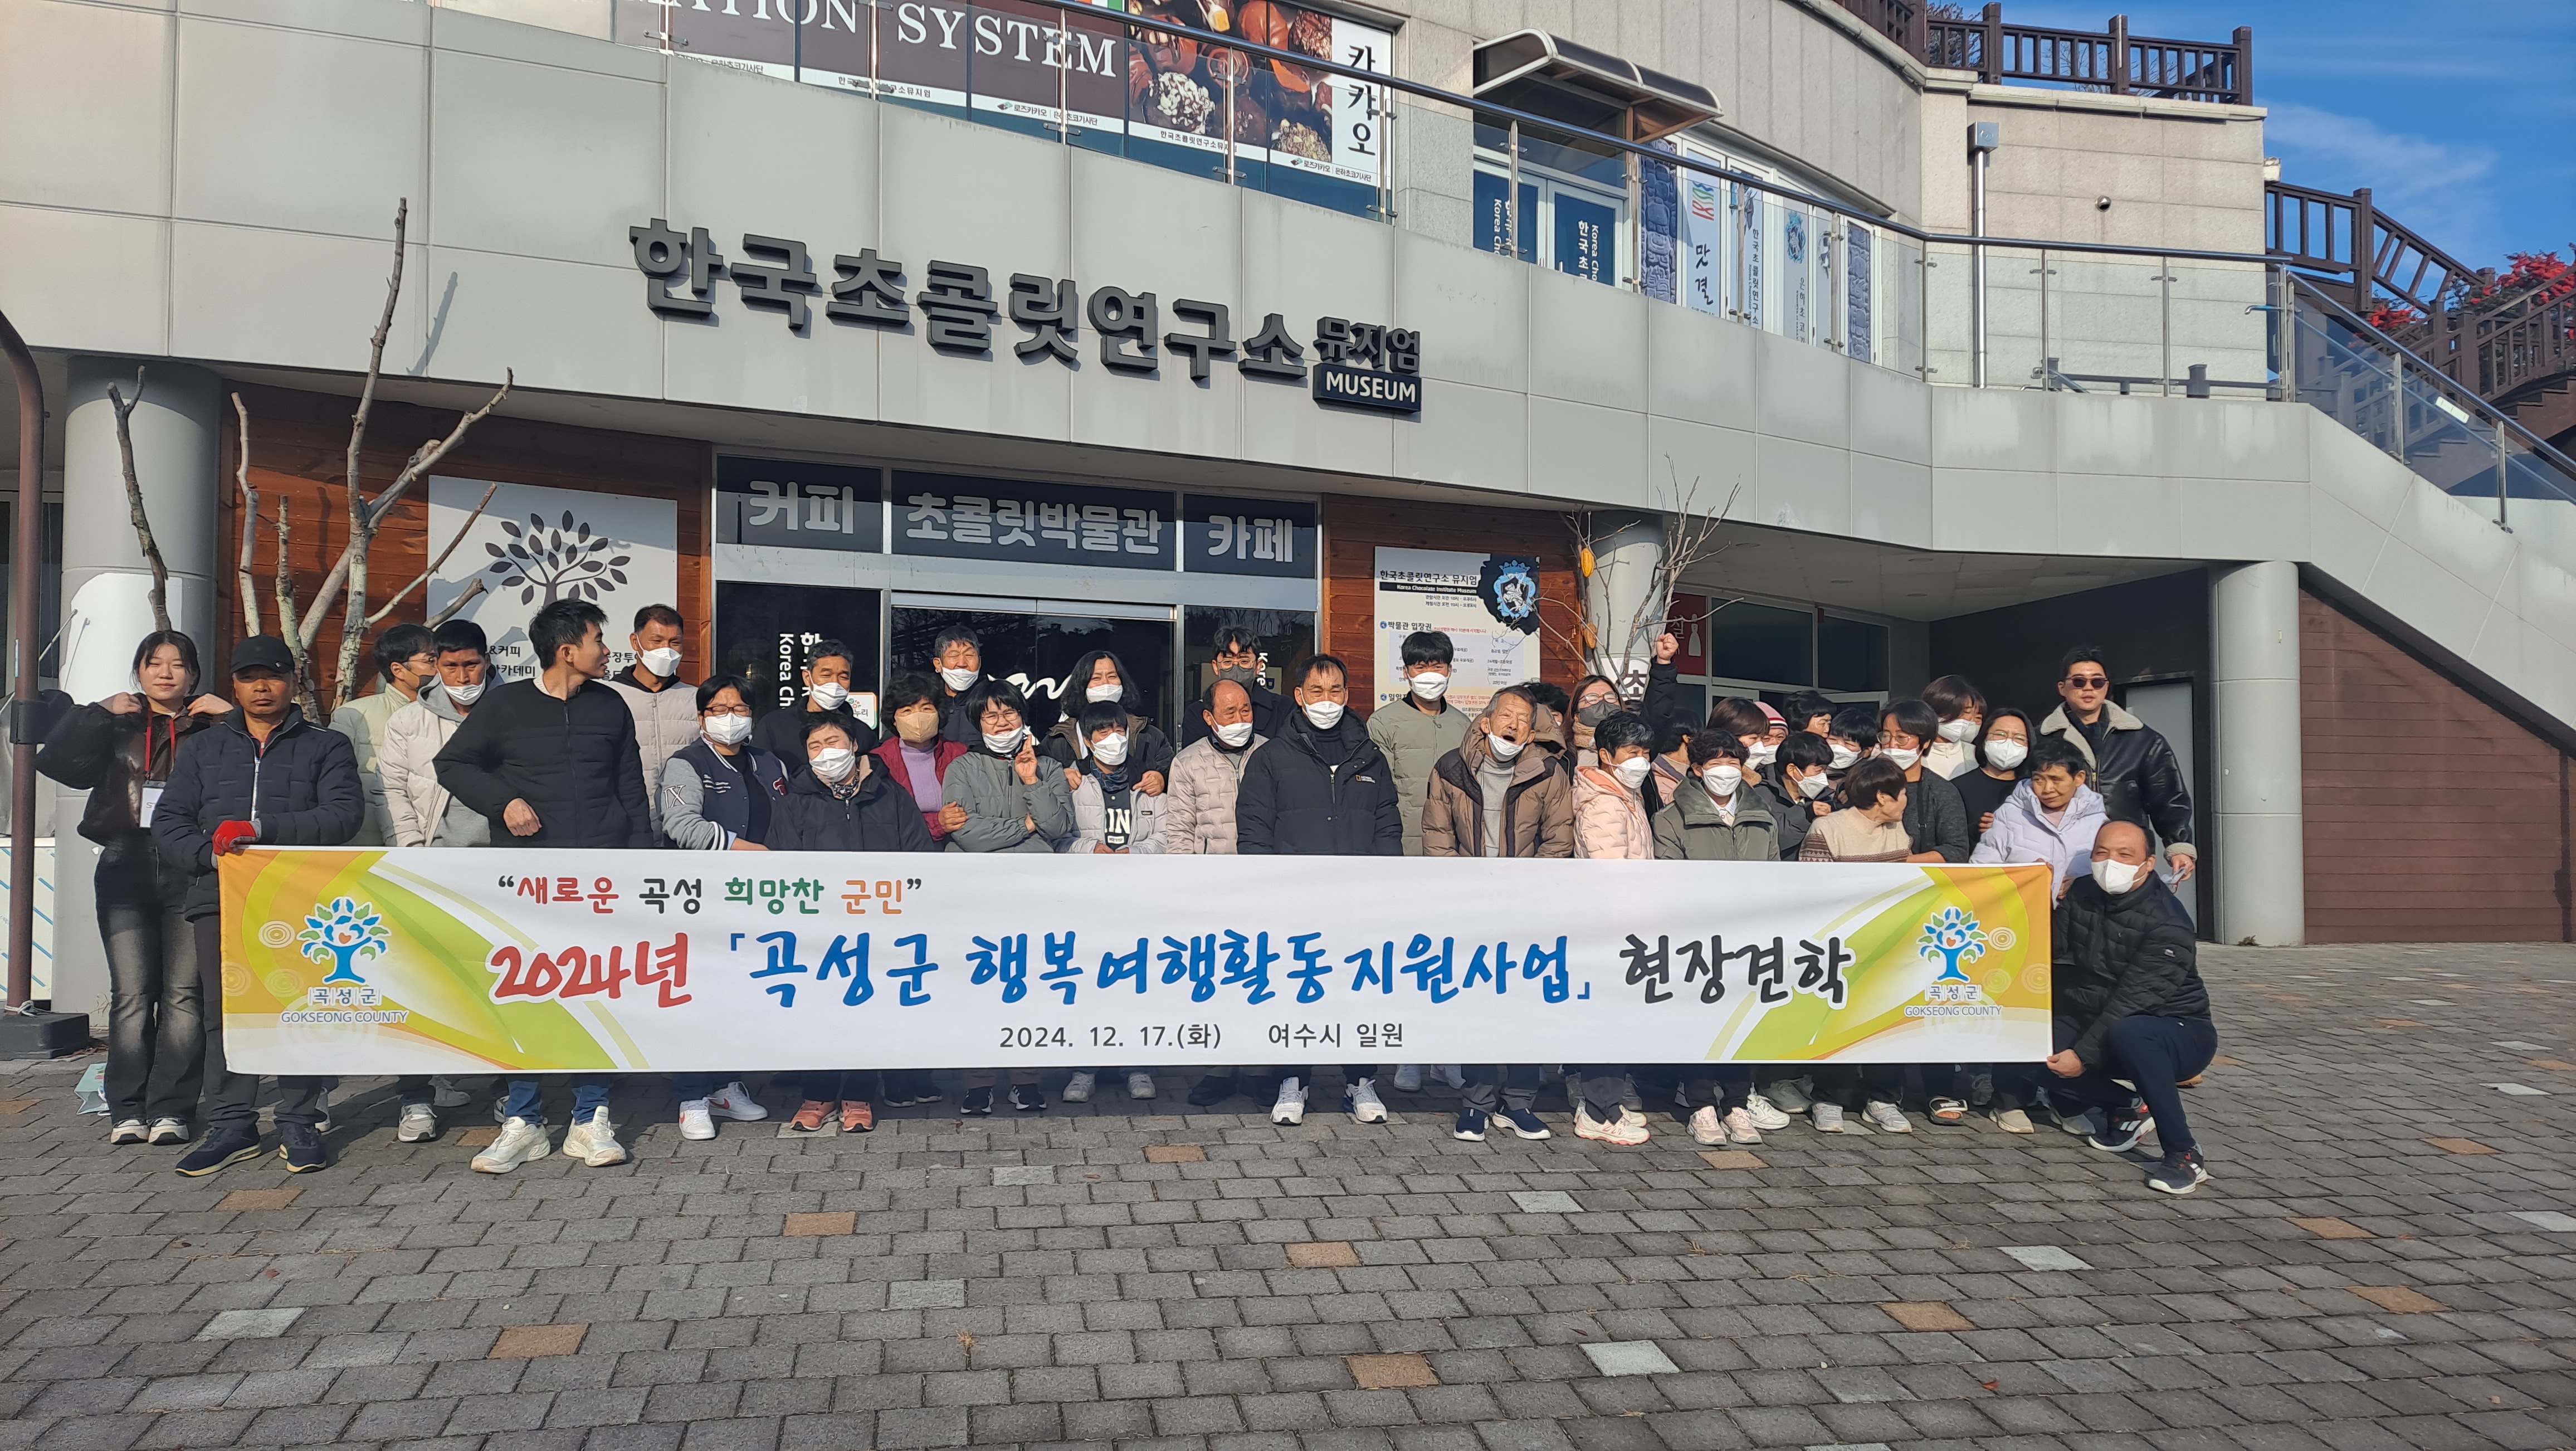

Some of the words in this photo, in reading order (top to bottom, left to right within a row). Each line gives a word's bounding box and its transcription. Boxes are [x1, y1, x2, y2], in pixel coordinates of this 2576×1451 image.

[898, 3, 1116, 77] SYSTEM
[1348, 45, 1376, 155] 카카오
[1494, 198, 1502, 232] Korea
[630, 218, 1308, 380] 한국초콜릿연구소
[1313, 317, 1421, 374] 뮤지엄
[1326, 371, 1416, 403] MUSEUM
[748, 480, 854, 534] 커피
[905, 492, 1162, 554] 초콜릿박물관
[1207, 514, 1294, 563] 카페
[1380, 570, 1449, 583] 한국초콜릿연구소
[1452, 574, 1477, 585] 뮤지엄
[1388, 621, 1409, 630] 박물관
[1411, 623, 1432, 631] 입장권
[779, 634, 794, 681] Korea
[779, 686, 795, 709] Ch
[1105, 808, 1130, 834] IN
[499, 875, 619, 913] “새로운
[639, 878, 702, 914] 곡성
[724, 877, 824, 914] 희망찬
[841, 878, 921, 914] 군민”
[491, 933, 692, 1008] 2024년
[1619, 934, 1851, 1004] 현장견학
[314, 989, 376, 1004] 곡성군
[1930, 986, 1977, 1000] 곡성군
[281, 1012, 352, 1022] GOKSEONG
[355, 1011, 408, 1022] COUNTY
[1905, 1006, 1959, 1016] GOKSEONG
[1962, 1006, 2002, 1016] COUNTY
[1000, 1027, 1074, 1048] 2024.
[1090, 1026, 1124, 1047] 12.
[1140, 1024, 1221, 1049] 17.(화)
[1269, 1024, 1341, 1048] 여수시
[1357, 1023, 1403, 1048] 일원
